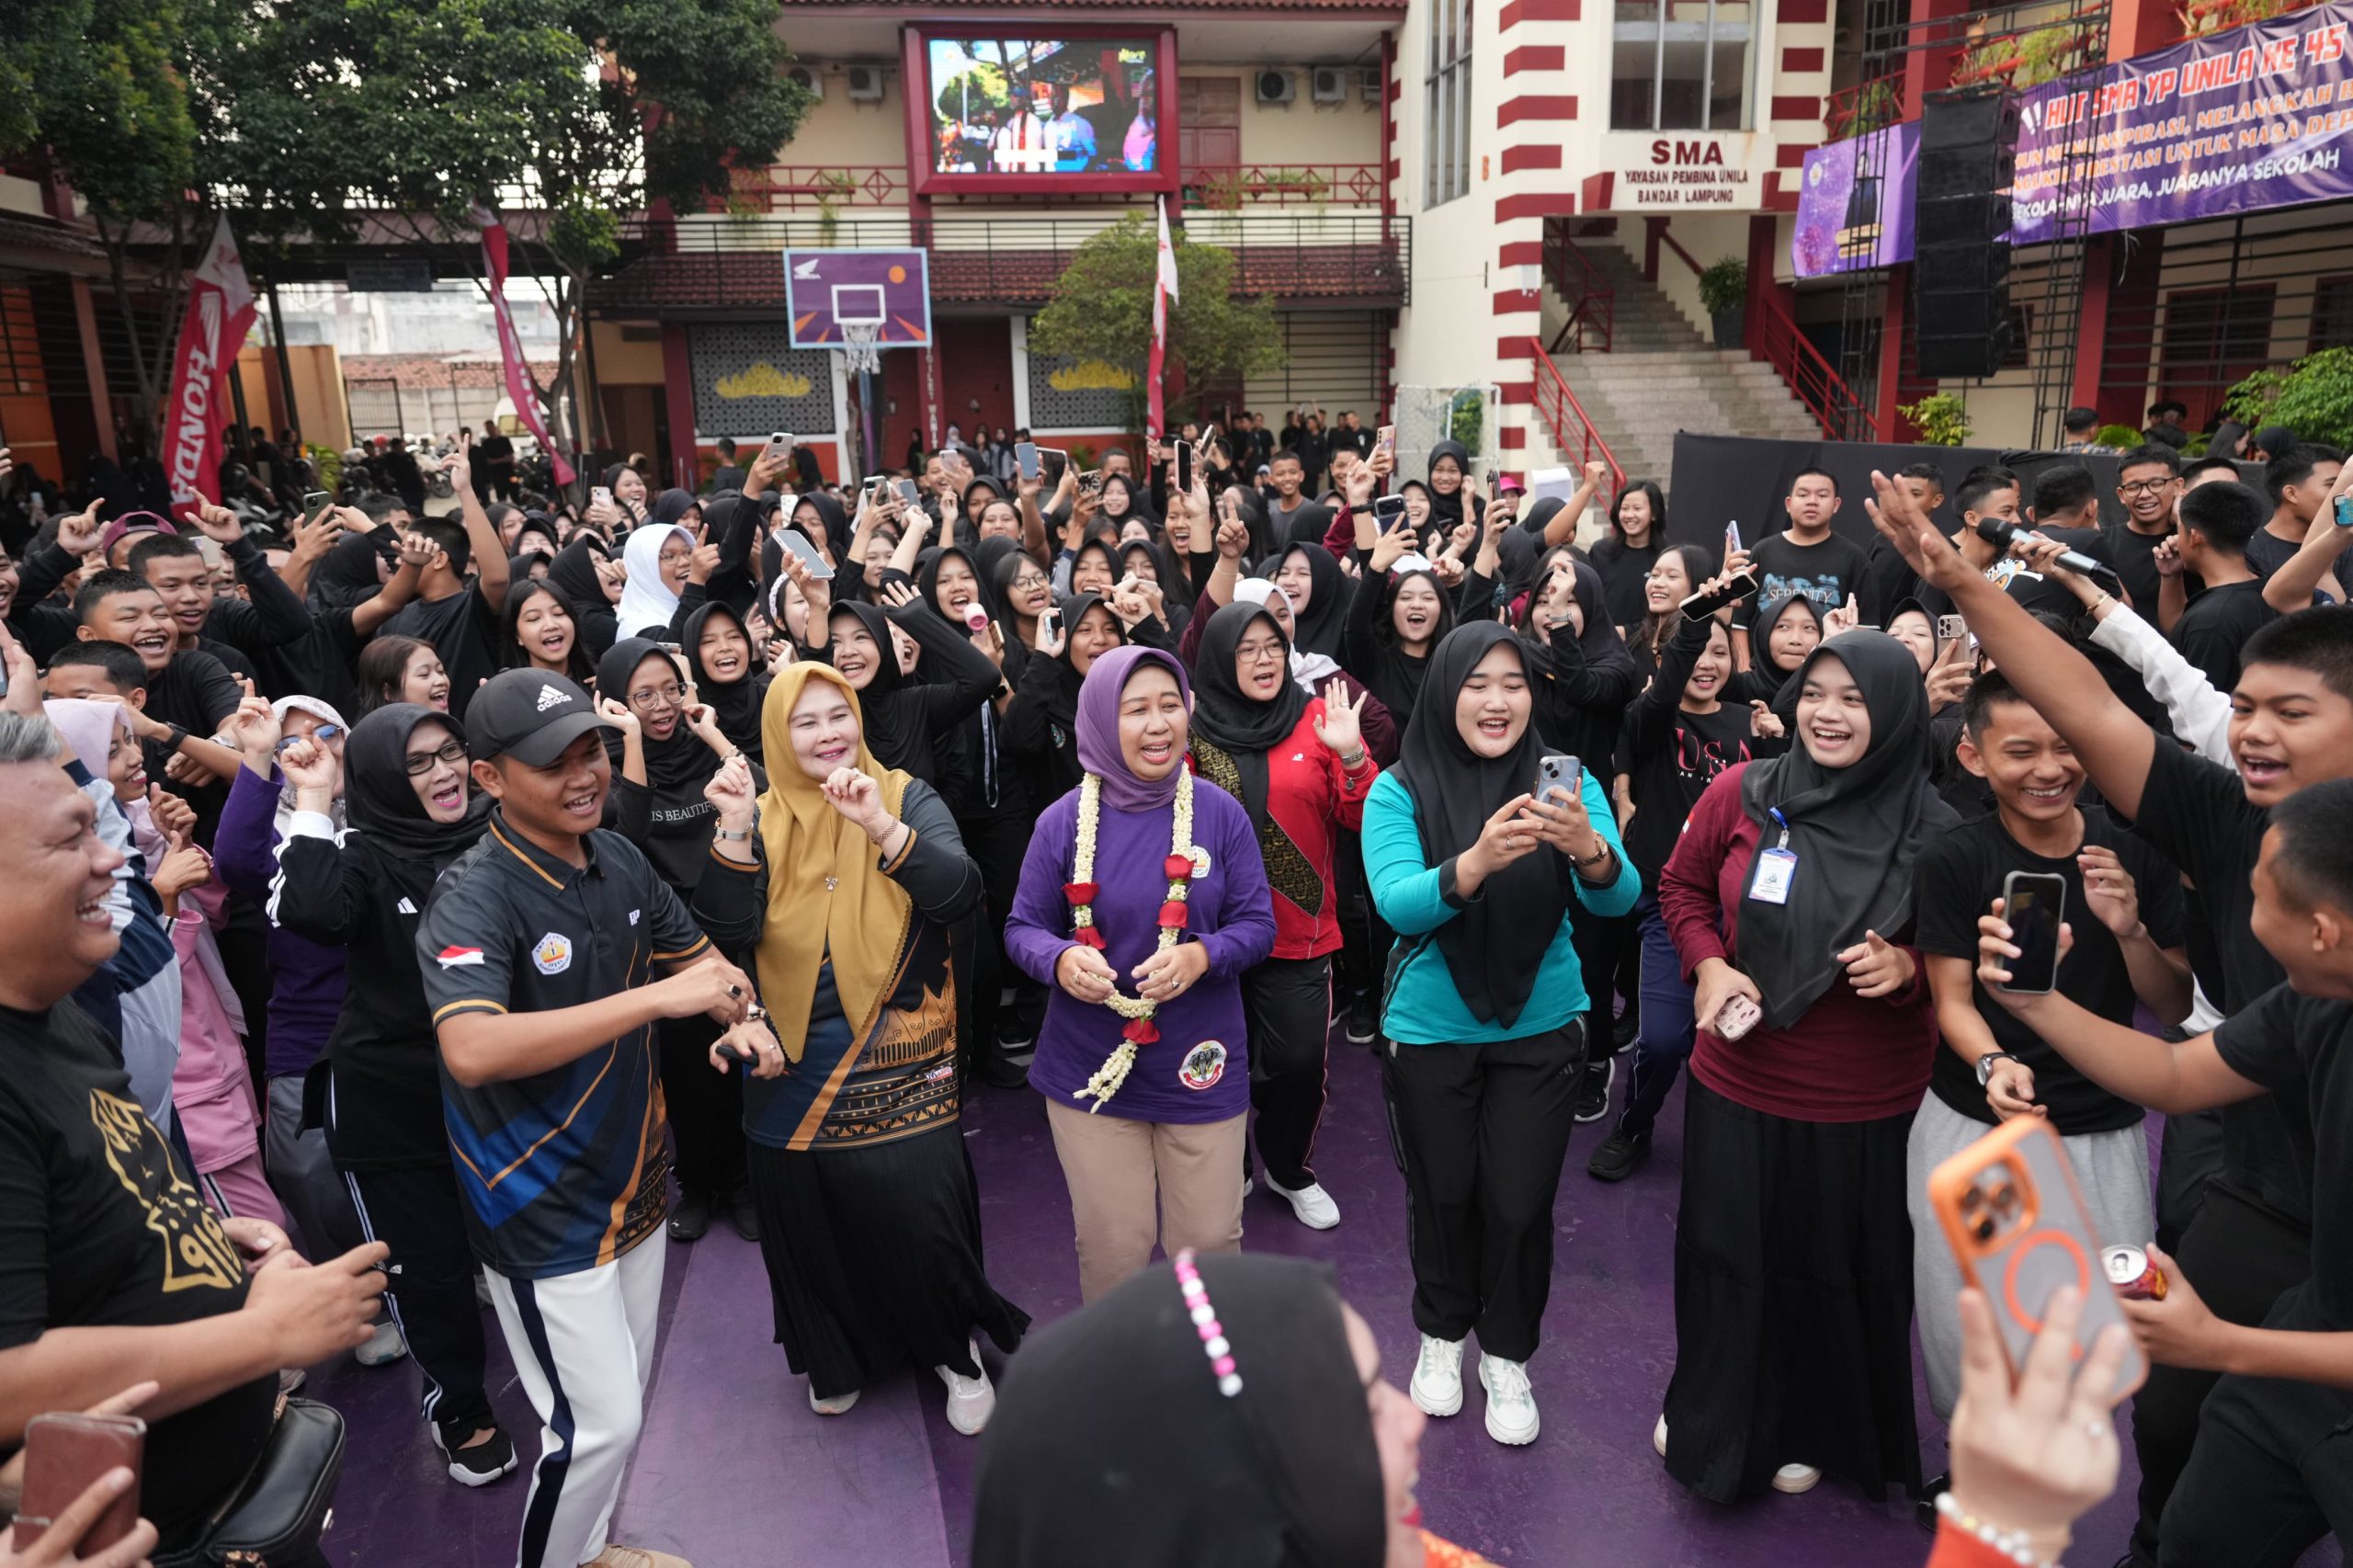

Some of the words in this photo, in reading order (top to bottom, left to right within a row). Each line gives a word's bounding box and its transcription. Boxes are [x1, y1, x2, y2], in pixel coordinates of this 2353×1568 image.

[2044, 90, 2089, 131] HUT
[2092, 76, 2140, 119] SMA
[2144, 67, 2177, 106] YP
[2179, 46, 2256, 97] UNILA
[2258, 35, 2298, 78] KE
[2304, 22, 2347, 66] 45
[2015, 148, 2043, 171] HUN
[2196, 83, 2334, 131] MELANGKAH
[1651, 139, 1723, 165] SMA
[2013, 165, 2070, 191] NGUKIR
[2074, 147, 2163, 182] PRESTASI
[2165, 131, 2234, 164] UNTUK
[2237, 119, 2299, 150] MASA
[1625, 170, 1669, 184] YAYASAN
[1671, 171, 1716, 184] PEMBINA
[1719, 169, 1748, 183] UNILA
[1638, 189, 1679, 203] BANDAR
[1685, 189, 1733, 202] LAMPUNG
[2098, 180, 2153, 206] JUARA,
[2155, 163, 2248, 197] JUARANYA
[2253, 147, 2340, 180] SEKOLAH
[168, 345, 211, 505] HONDA
[928, 404, 938, 449] WANIT
[537, 694, 573, 712] adidas
[651, 810, 663, 822] IS
